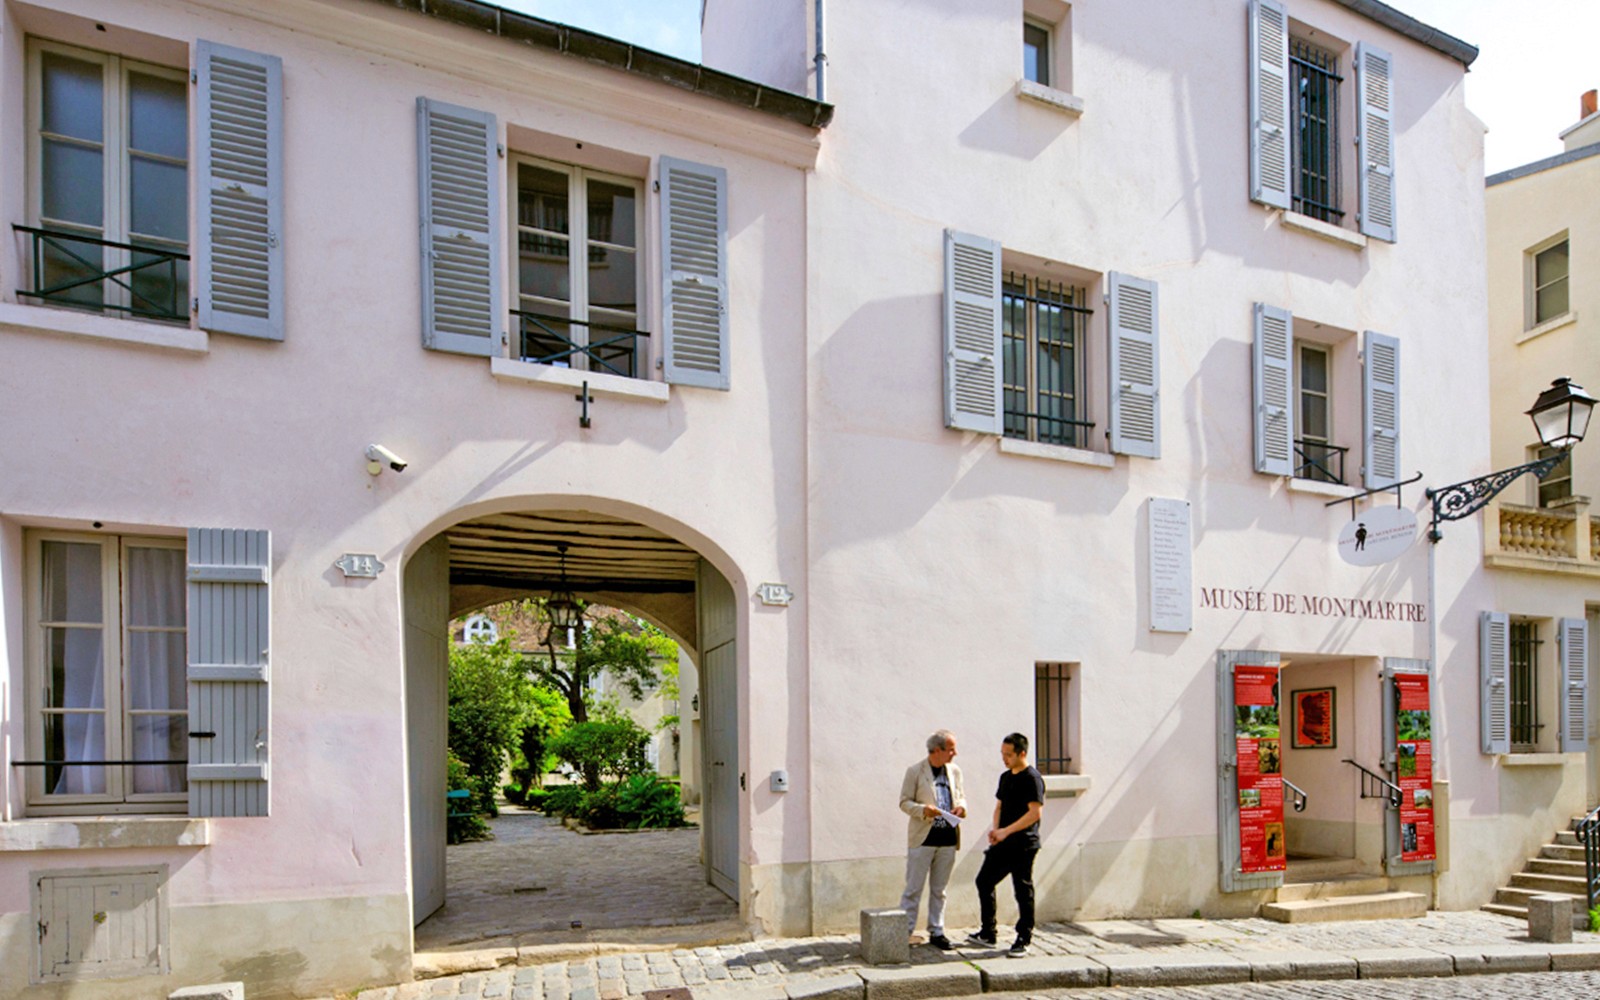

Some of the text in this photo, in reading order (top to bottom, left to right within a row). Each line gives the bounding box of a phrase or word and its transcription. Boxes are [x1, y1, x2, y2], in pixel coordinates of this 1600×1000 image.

[351, 556, 372, 573] 14
[1200, 586, 1267, 611] MUSÉE
[1272, 592, 1296, 614] DE
[1301, 595, 1427, 622] MONTMARTRE
